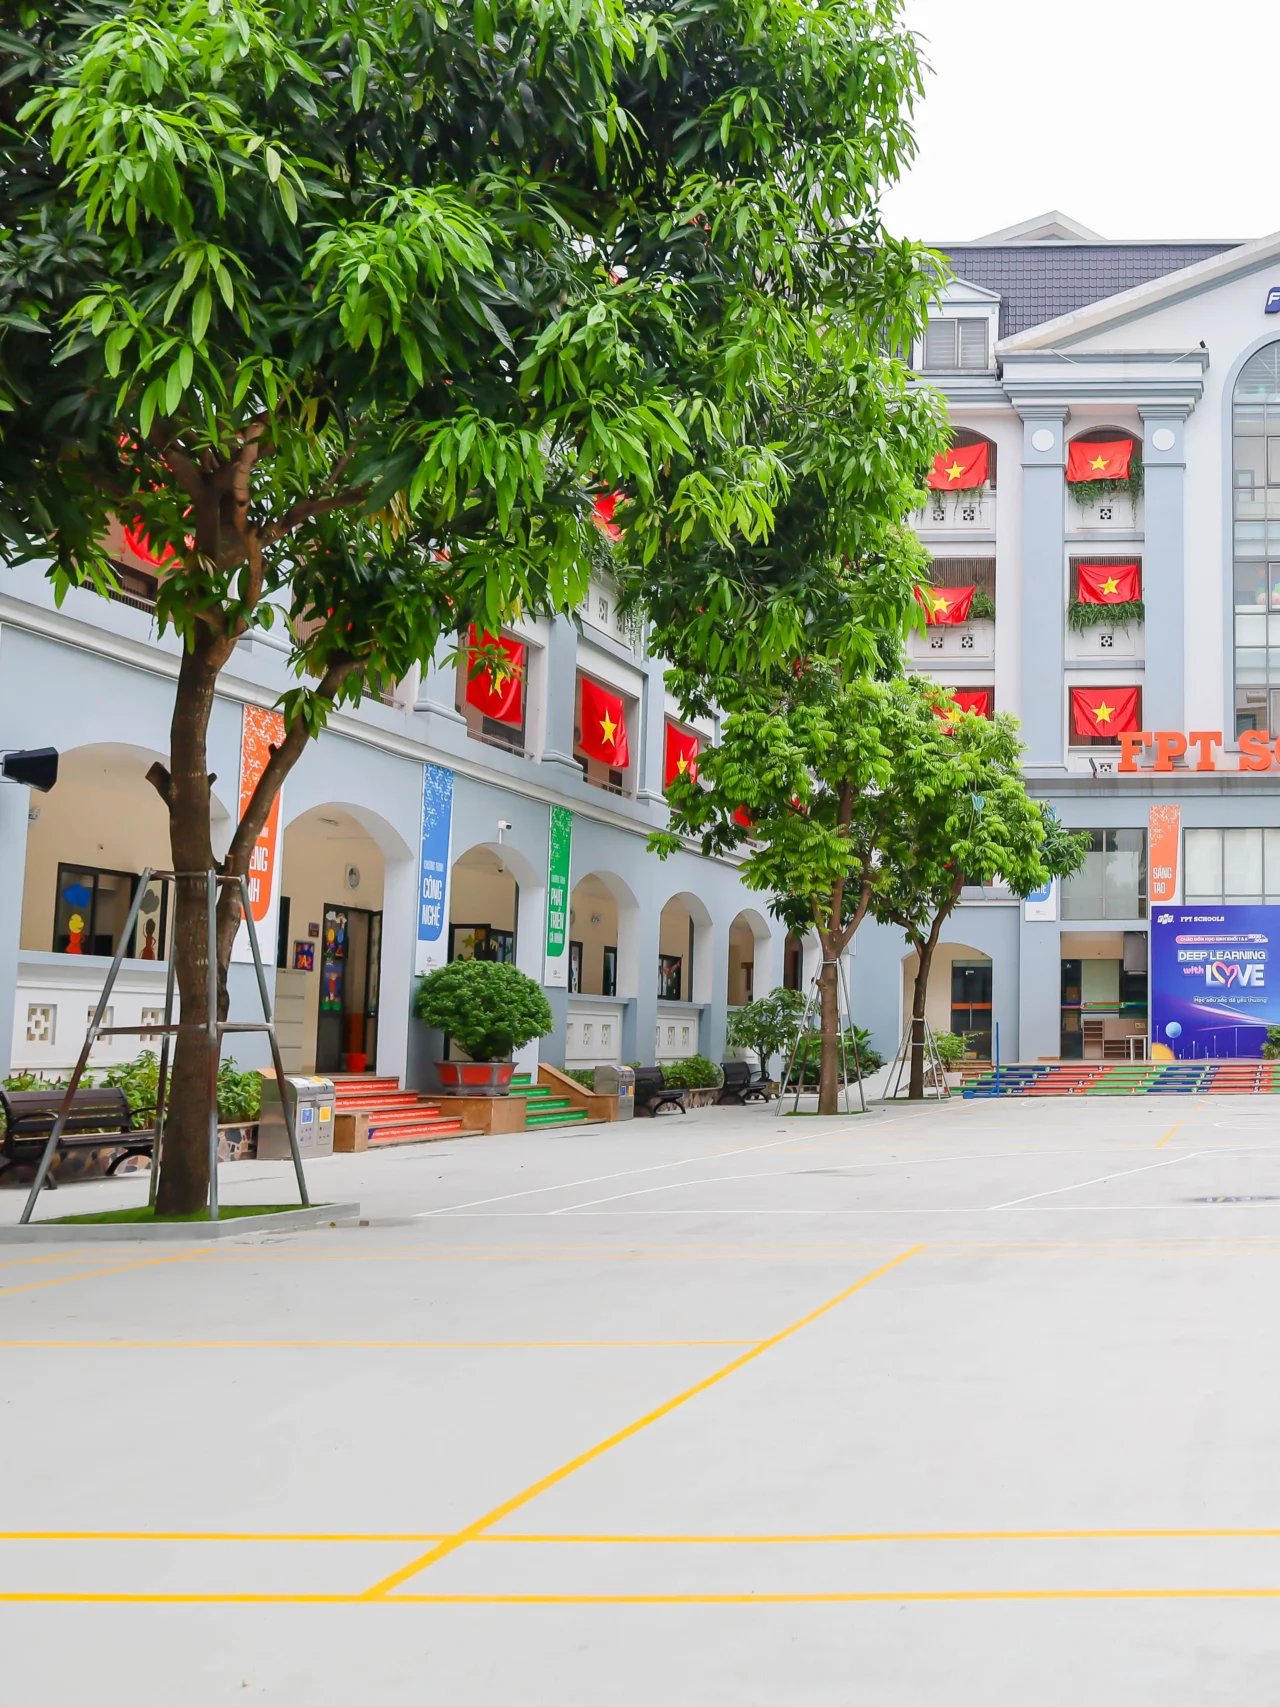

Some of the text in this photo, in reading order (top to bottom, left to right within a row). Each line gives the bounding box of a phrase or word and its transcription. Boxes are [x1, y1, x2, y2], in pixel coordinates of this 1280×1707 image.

[1118, 731, 1222, 772] FPT
[1152, 866, 1172, 879] SÁNG
[423, 876, 442, 900] CÔNG
[551, 886, 563, 906] PHÁT
[1153, 882, 1166, 895] TẠO
[422, 903, 440, 929] NGHỆ
[550, 907, 564, 930] TRIỂN
[1179, 951, 1265, 960] DEEP LEARNING
[1183, 965, 1204, 974] with
